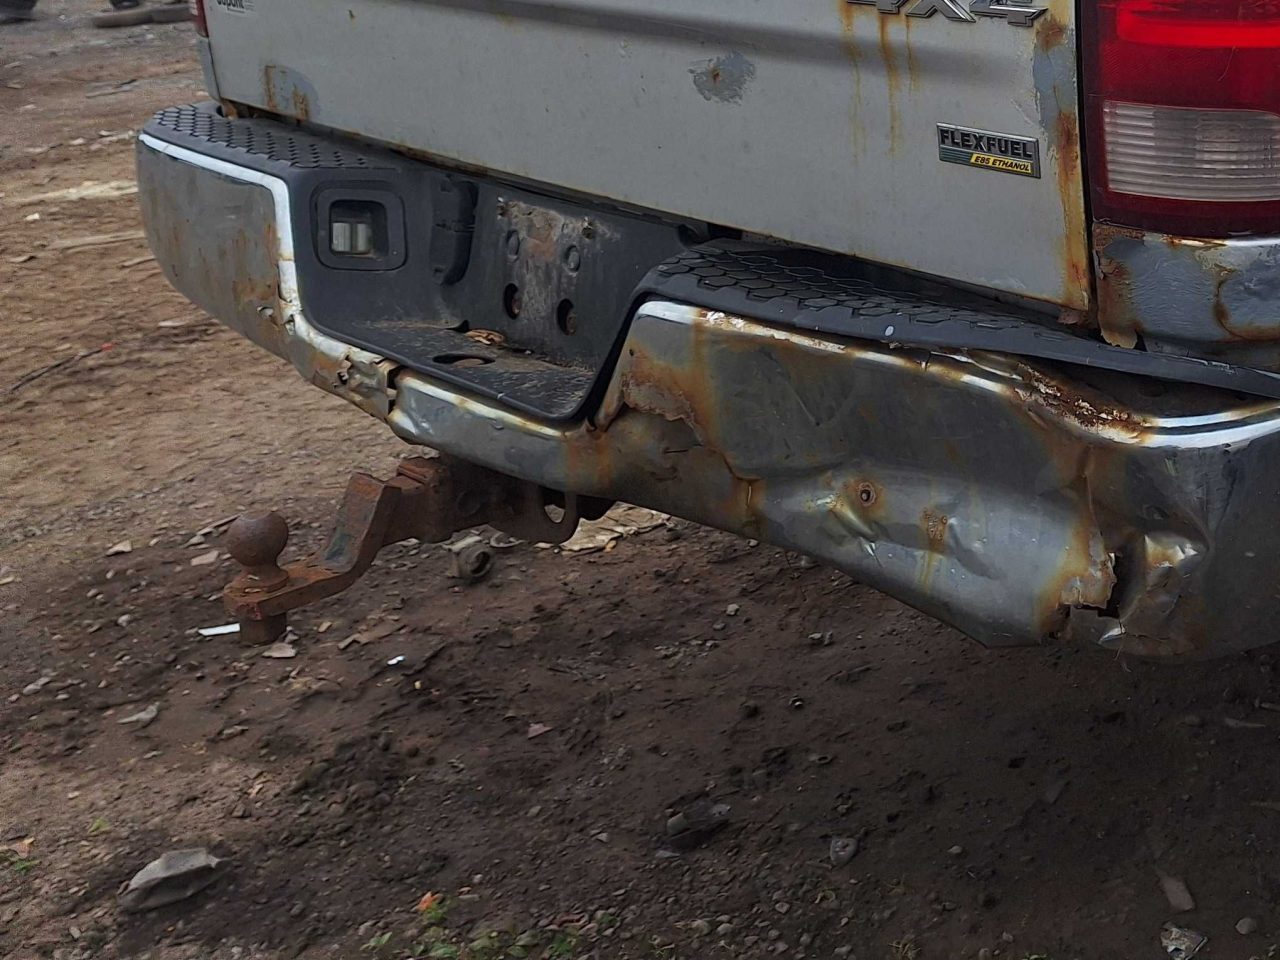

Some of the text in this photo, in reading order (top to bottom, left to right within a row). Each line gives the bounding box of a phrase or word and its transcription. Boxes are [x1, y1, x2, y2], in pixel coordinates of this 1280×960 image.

[939, 129, 1033, 159] FLEXFUEL
[974, 154, 1031, 172] E85 ETHANOL
